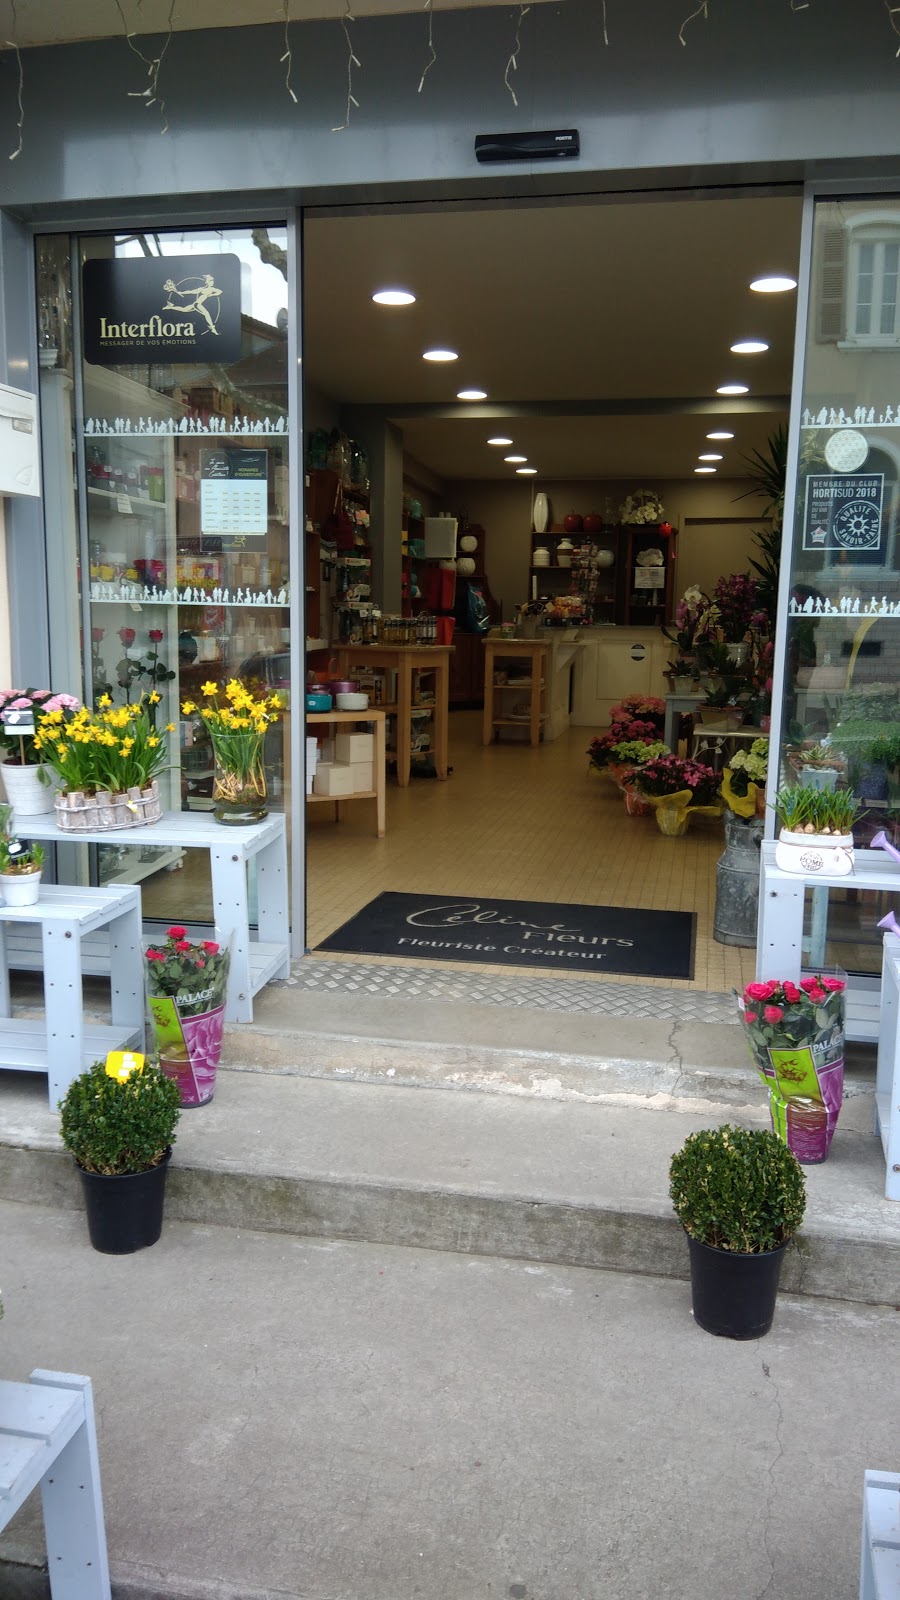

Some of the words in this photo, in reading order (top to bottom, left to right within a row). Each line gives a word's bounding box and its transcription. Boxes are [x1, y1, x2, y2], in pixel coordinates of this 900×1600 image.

[99, 315, 196, 339] Interflora
[812, 480, 843, 488] MEMBRE
[812, 488, 855, 498] HORTISUD
[855, 487, 877, 498] 2018
[839, 518, 879, 545] SAVOIR-FAIRE
[523, 931, 635, 947] Fleurs
[397, 937, 497, 951] Fleuriste
[503, 945, 607, 959] Créateur
[175, 990, 213, 1004] PALACE
